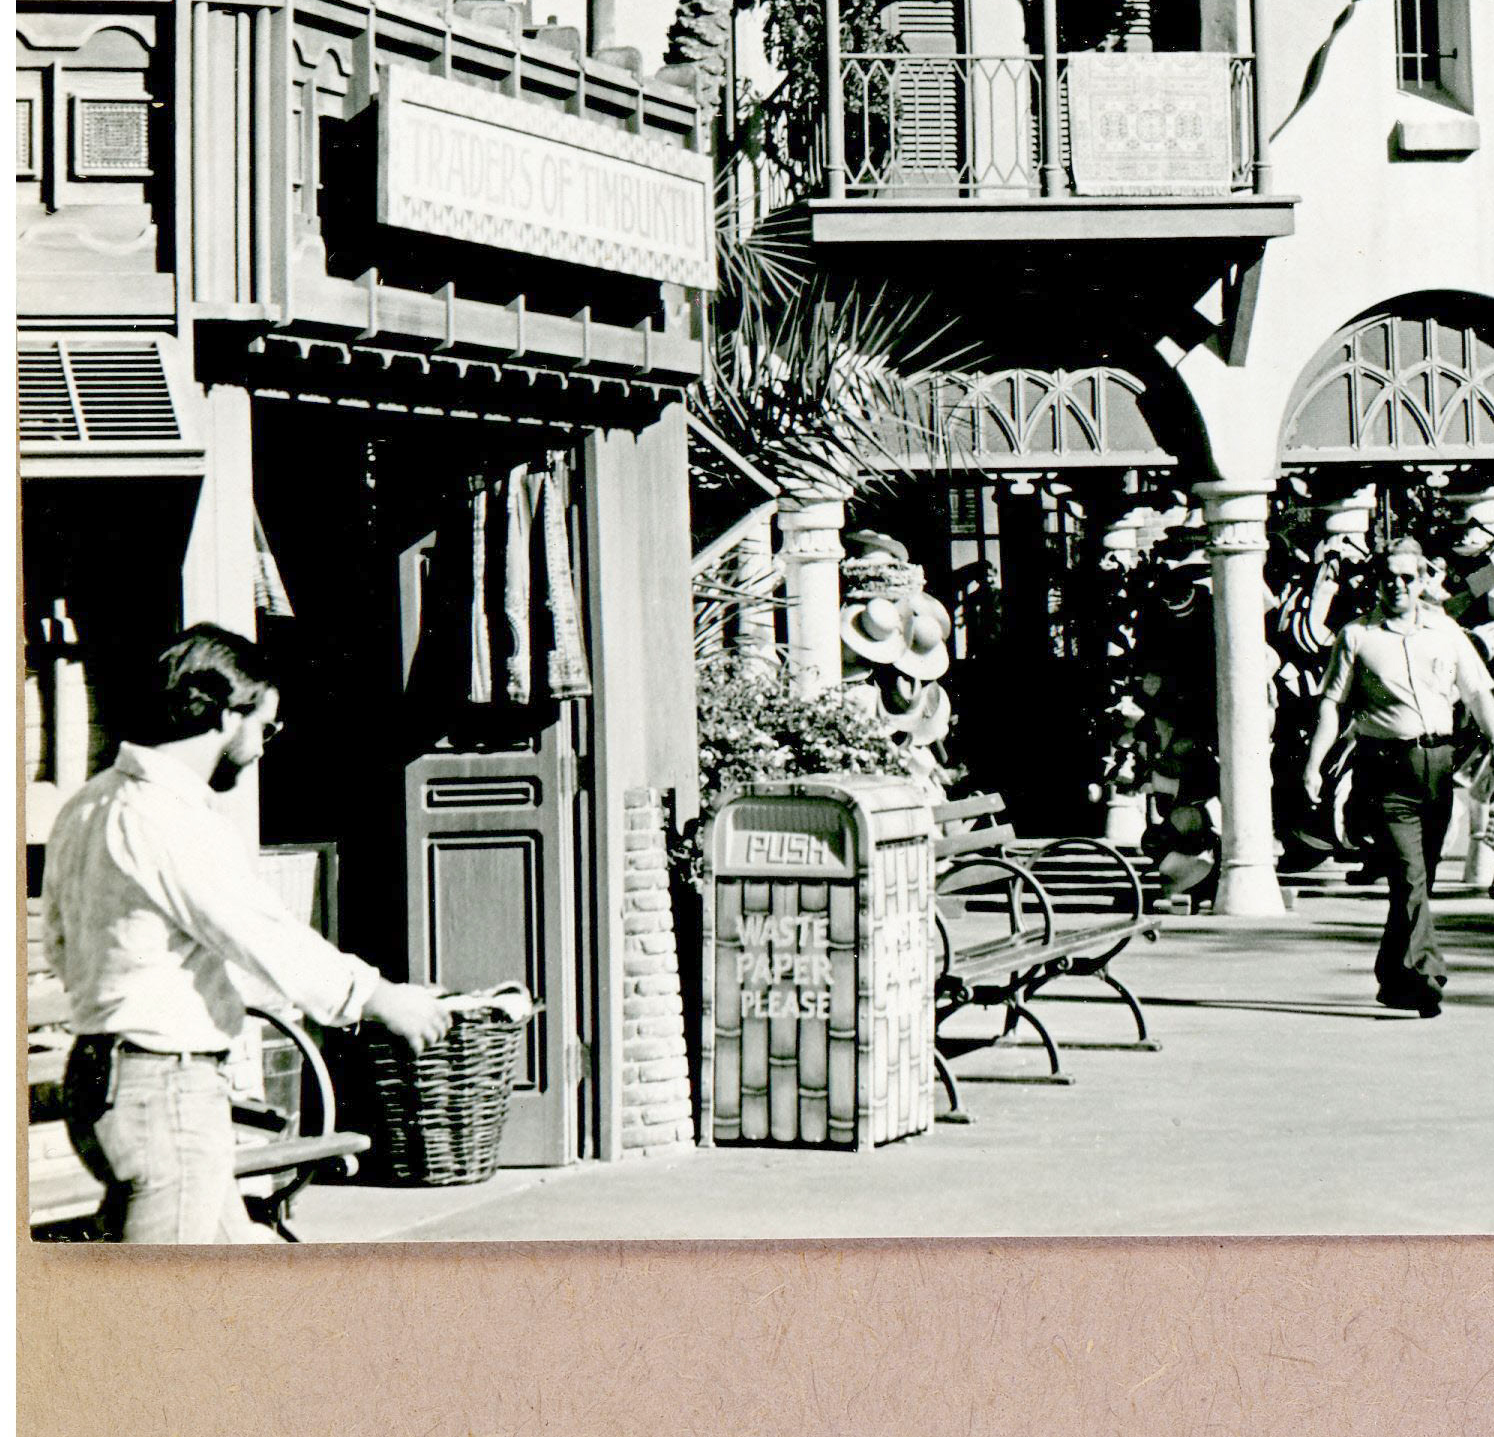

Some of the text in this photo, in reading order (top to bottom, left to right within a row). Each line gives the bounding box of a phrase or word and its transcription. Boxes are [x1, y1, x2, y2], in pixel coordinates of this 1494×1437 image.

[407, 116, 699, 249] TRADERS OF TIMBUKTU
[746, 834, 829, 865] PUSH
[736, 914, 830, 949] WASTE
[736, 952, 835, 986] PAPER
[741, 990, 831, 1020] PLEASE
